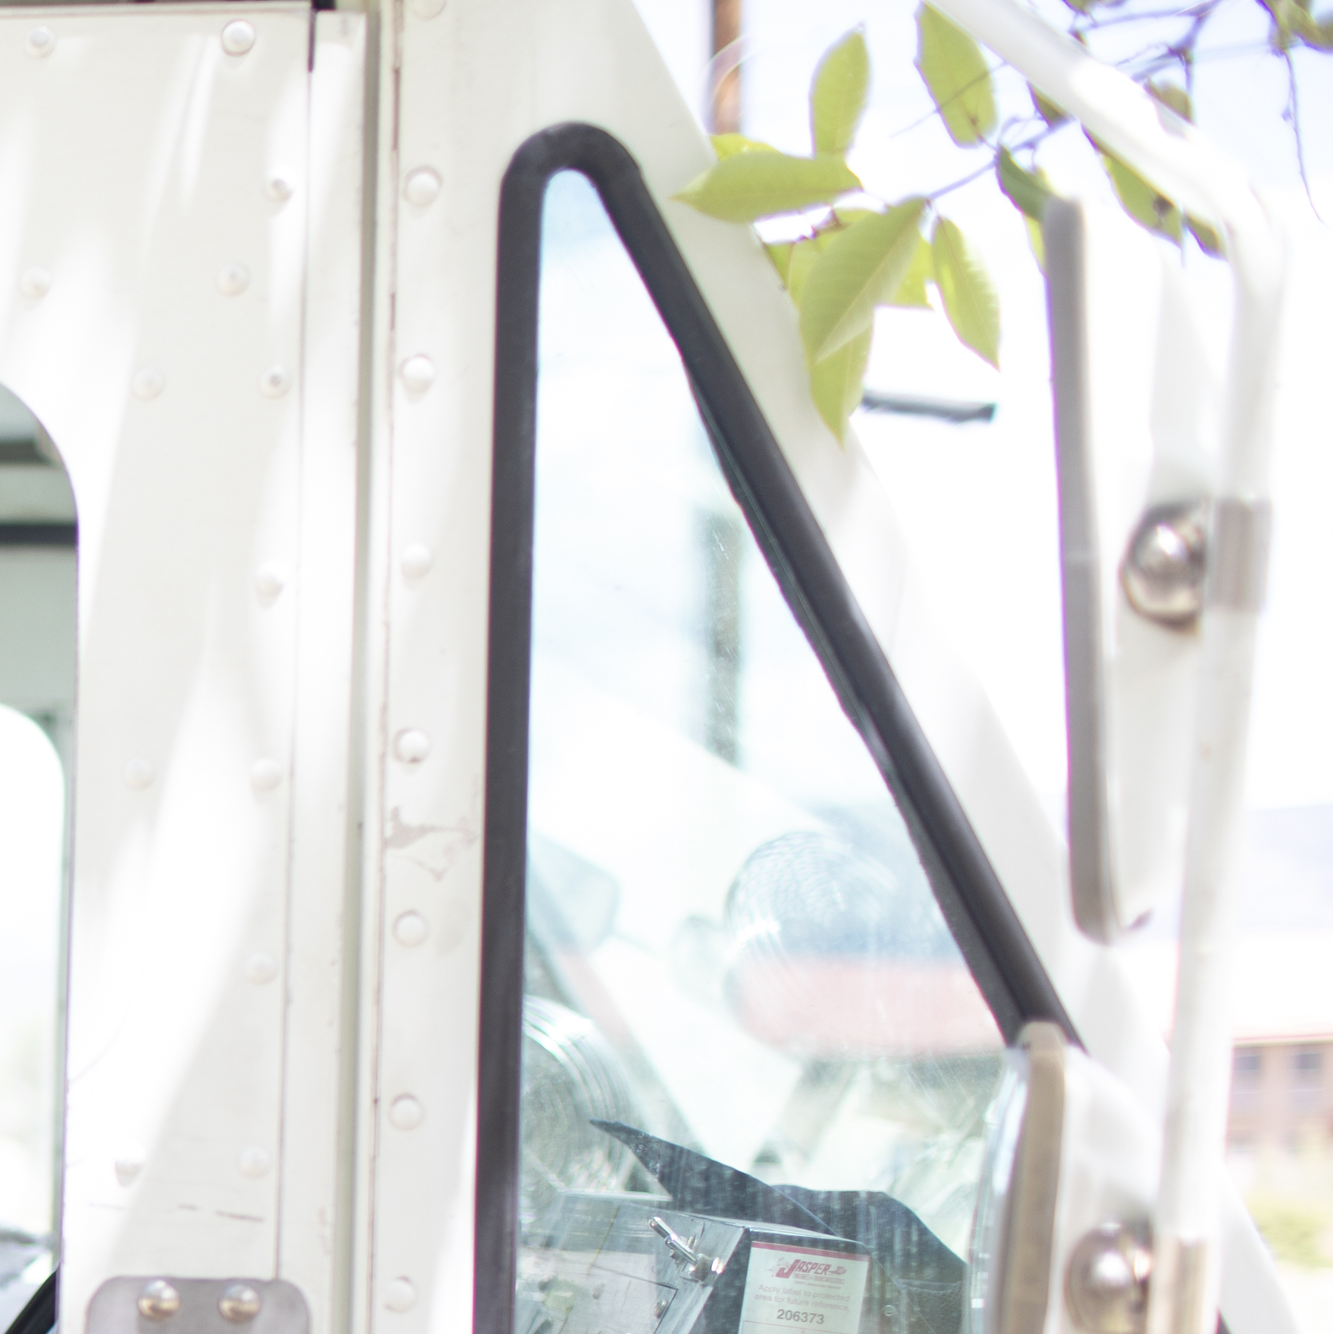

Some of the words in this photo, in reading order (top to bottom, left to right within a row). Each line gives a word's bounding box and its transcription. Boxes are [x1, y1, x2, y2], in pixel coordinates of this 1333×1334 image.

[775, 1258, 832, 1279] JASPER
[754, 1294, 772, 1302] area
[774, 1295, 784, 1303] for
[786, 1296, 809, 1306] future
[758, 1284, 780, 1294] Apply
[782, 1286, 801, 1296] label
[803, 1289, 811, 1297] to
[813, 1290, 850, 1302] protected
[777, 1308, 824, 1325] 206373
